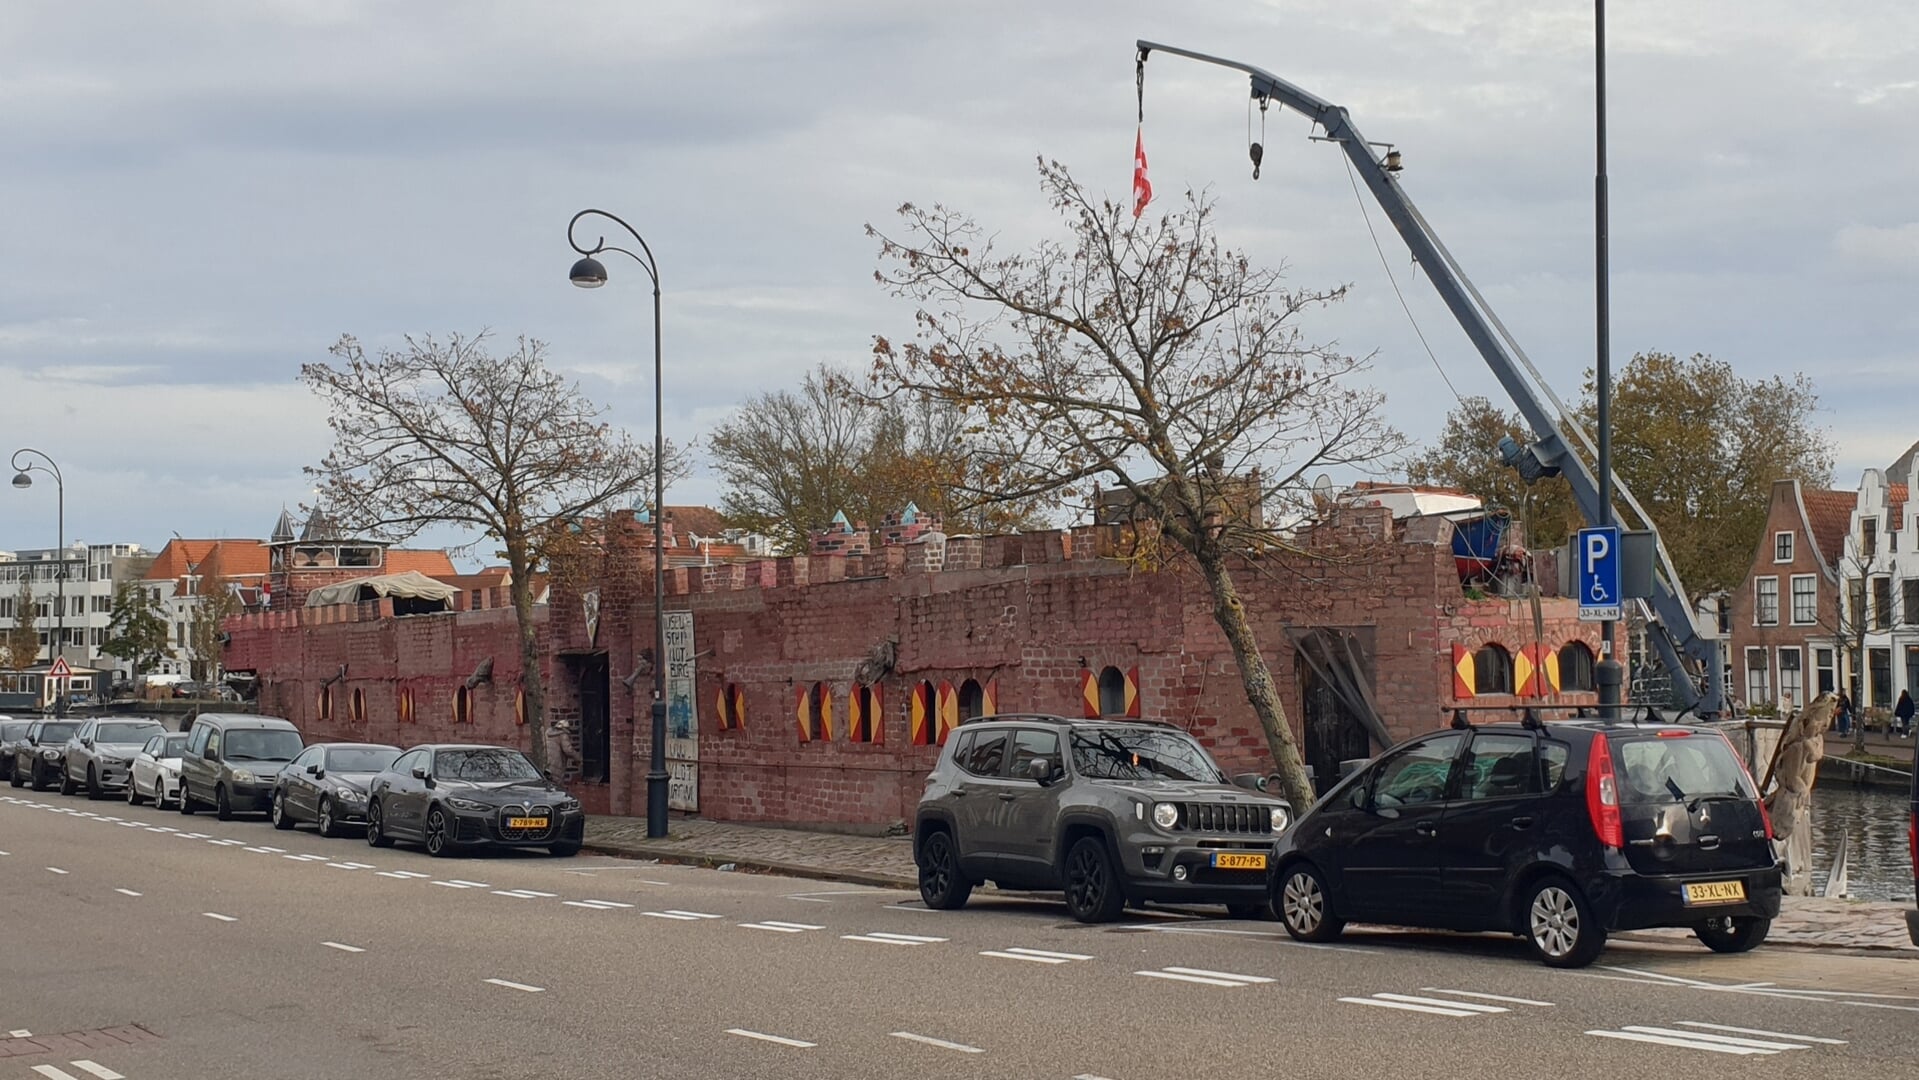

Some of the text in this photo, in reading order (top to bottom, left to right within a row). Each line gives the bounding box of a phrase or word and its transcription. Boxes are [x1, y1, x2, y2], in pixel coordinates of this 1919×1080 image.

[1587, 534, 1609, 574] P
[1580, 608, 1617, 617] 33-XL-NX
[1220, 855, 1262, 867] S-877-PS
[1691, 883, 1740, 898] 33-XL-NX
